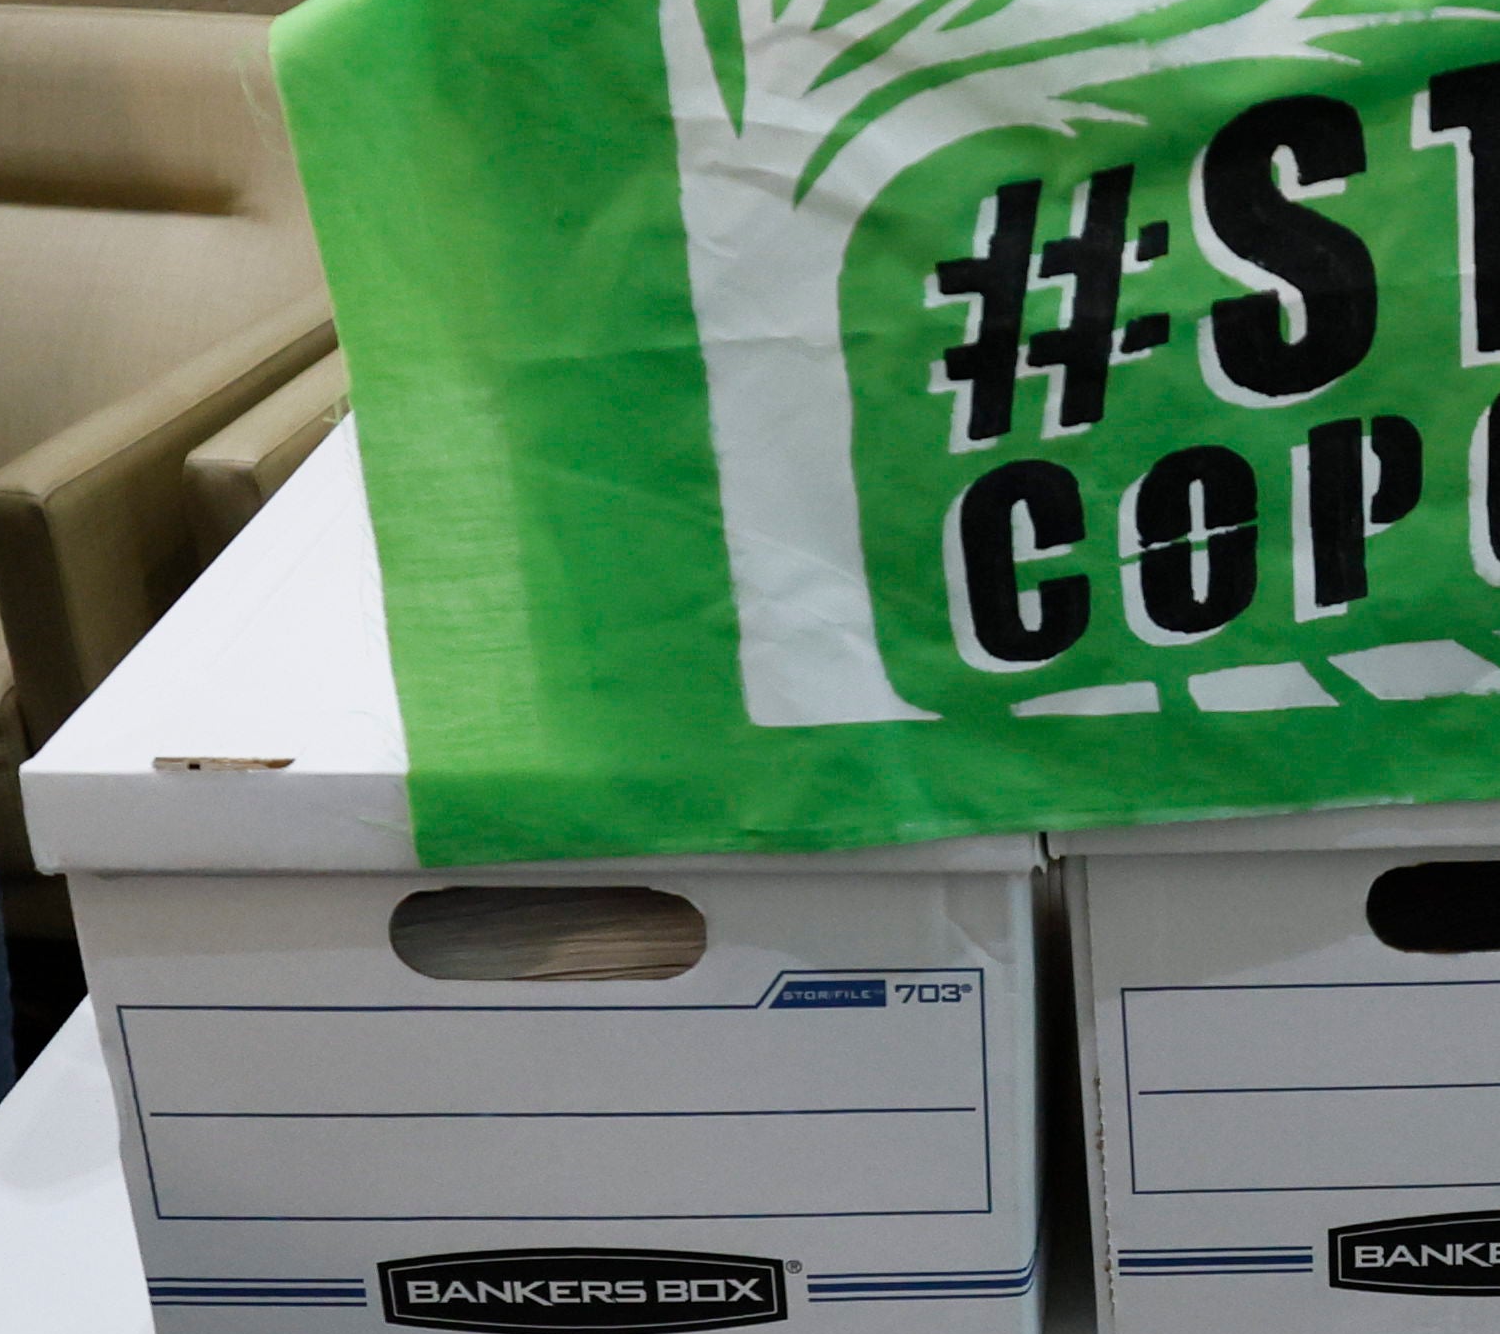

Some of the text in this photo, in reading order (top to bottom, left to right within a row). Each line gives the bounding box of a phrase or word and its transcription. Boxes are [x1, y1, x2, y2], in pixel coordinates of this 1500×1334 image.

[942, 416, 1424, 672] COP
[406, 1278, 763, 1306] BANKERS BOX
